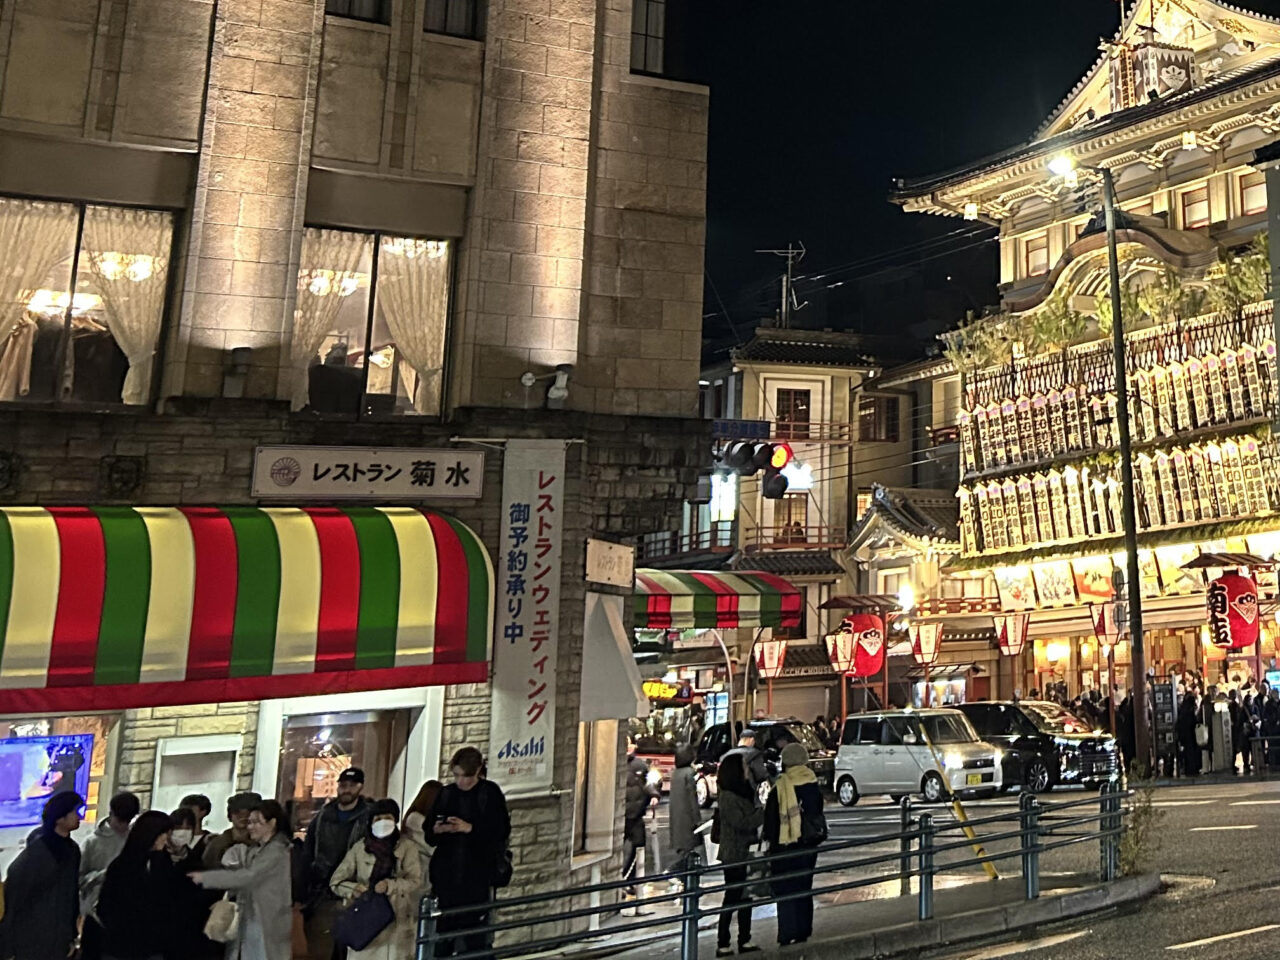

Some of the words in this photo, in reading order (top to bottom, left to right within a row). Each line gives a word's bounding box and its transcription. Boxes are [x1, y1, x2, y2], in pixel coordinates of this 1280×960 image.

[313, 462, 403, 482] レストラン
[410, 459, 470, 488] 菊水
[503, 502, 531, 645] 御予約承り中
[526, 470, 556, 726] レストランウェディング
[497, 735, 545, 759] Asahi
